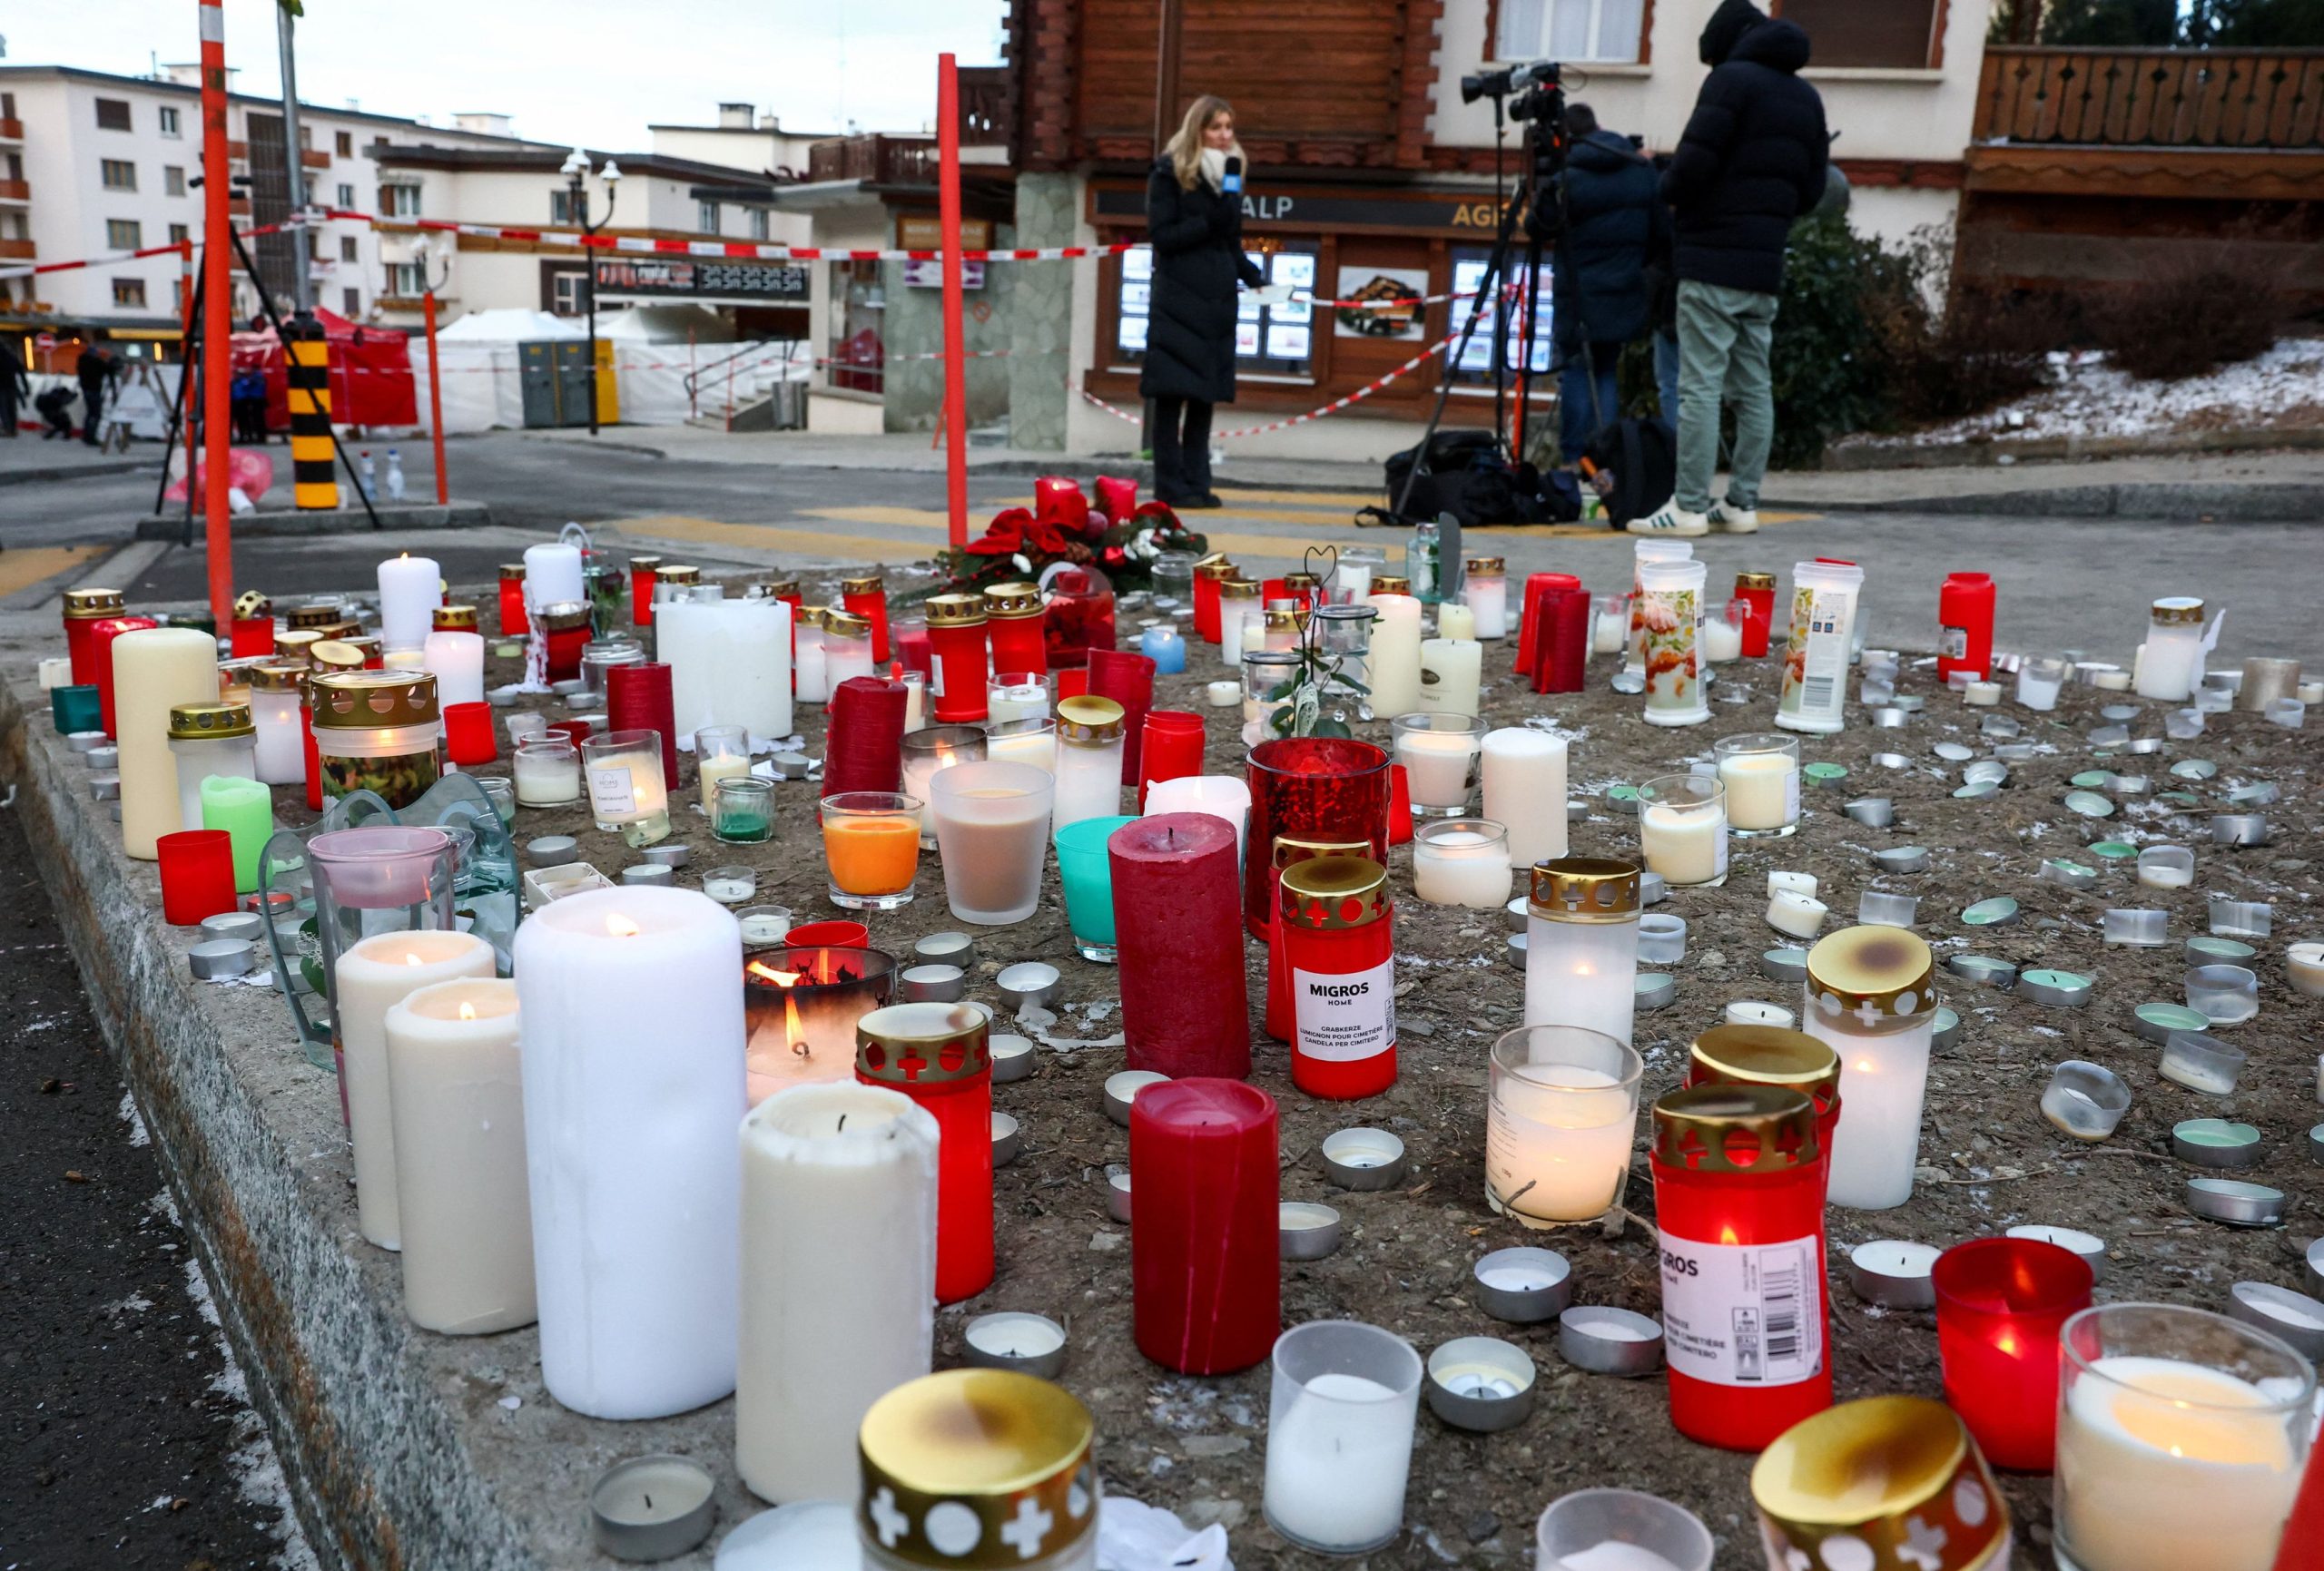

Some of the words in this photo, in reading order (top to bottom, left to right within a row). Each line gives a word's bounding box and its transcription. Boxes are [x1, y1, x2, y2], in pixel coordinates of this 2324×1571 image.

[1241, 194, 1294, 220] ALP
[1309, 982, 1369, 997] MIGROS
[1299, 1027, 1331, 1039] LUMIGNON
[1332, 1032, 1352, 1040] POUR
[1353, 1025, 1384, 1038] CIMETIÈRE
[1305, 1036, 1334, 1047] CANDELA
[1350, 1035, 1379, 1046] CIMITERO
